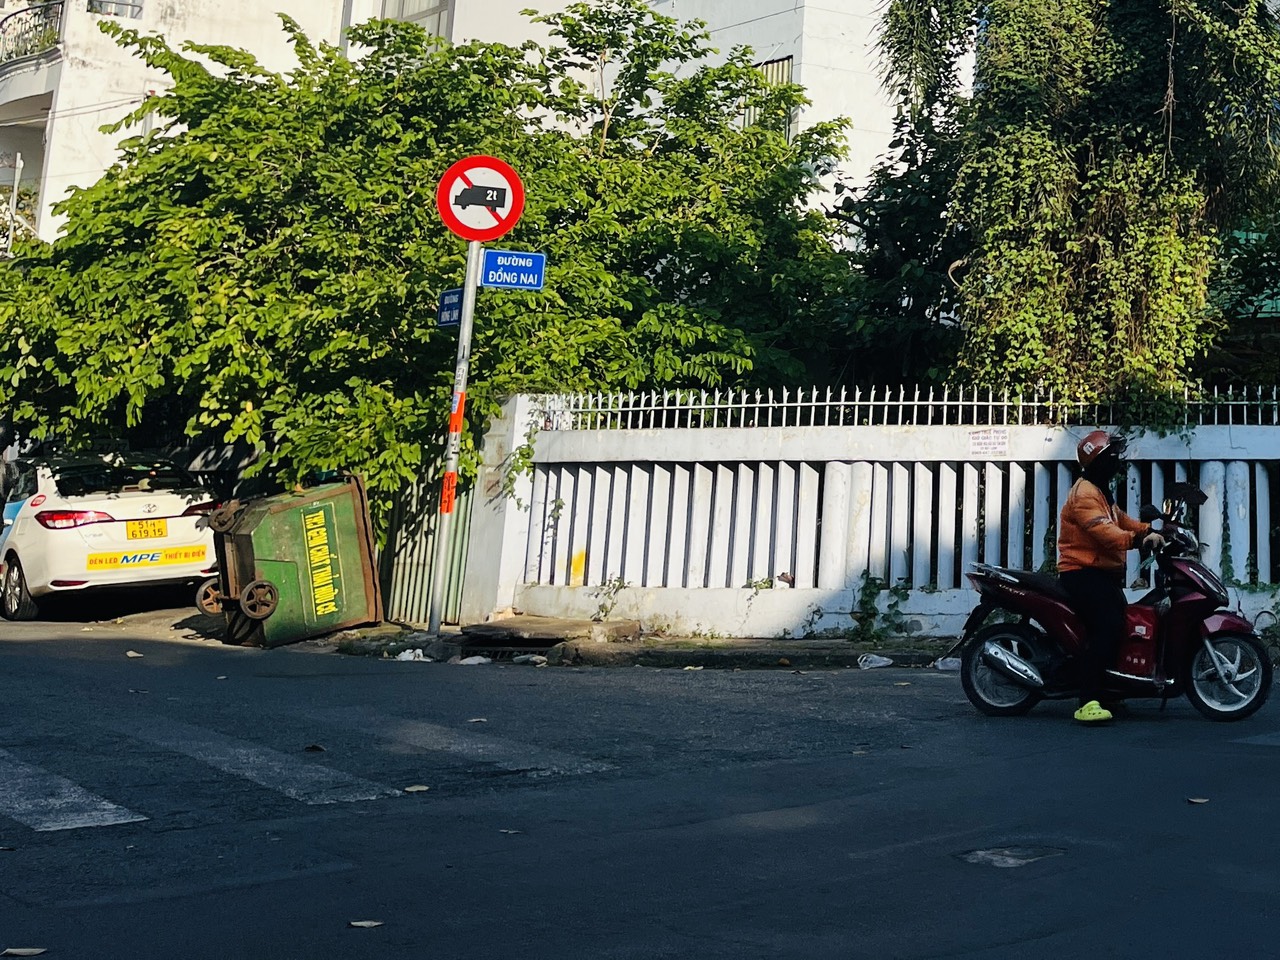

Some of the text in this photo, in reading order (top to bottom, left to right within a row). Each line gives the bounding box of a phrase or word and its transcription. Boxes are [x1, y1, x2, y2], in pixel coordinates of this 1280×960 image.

[486, 190, 498, 201] 2t
[497, 255, 533, 267] ĐƯỜNG
[489, 268, 538, 285] ĐỒNG NAI
[132, 529, 163, 538] 619.15
[120, 552, 163, 564] MPE
